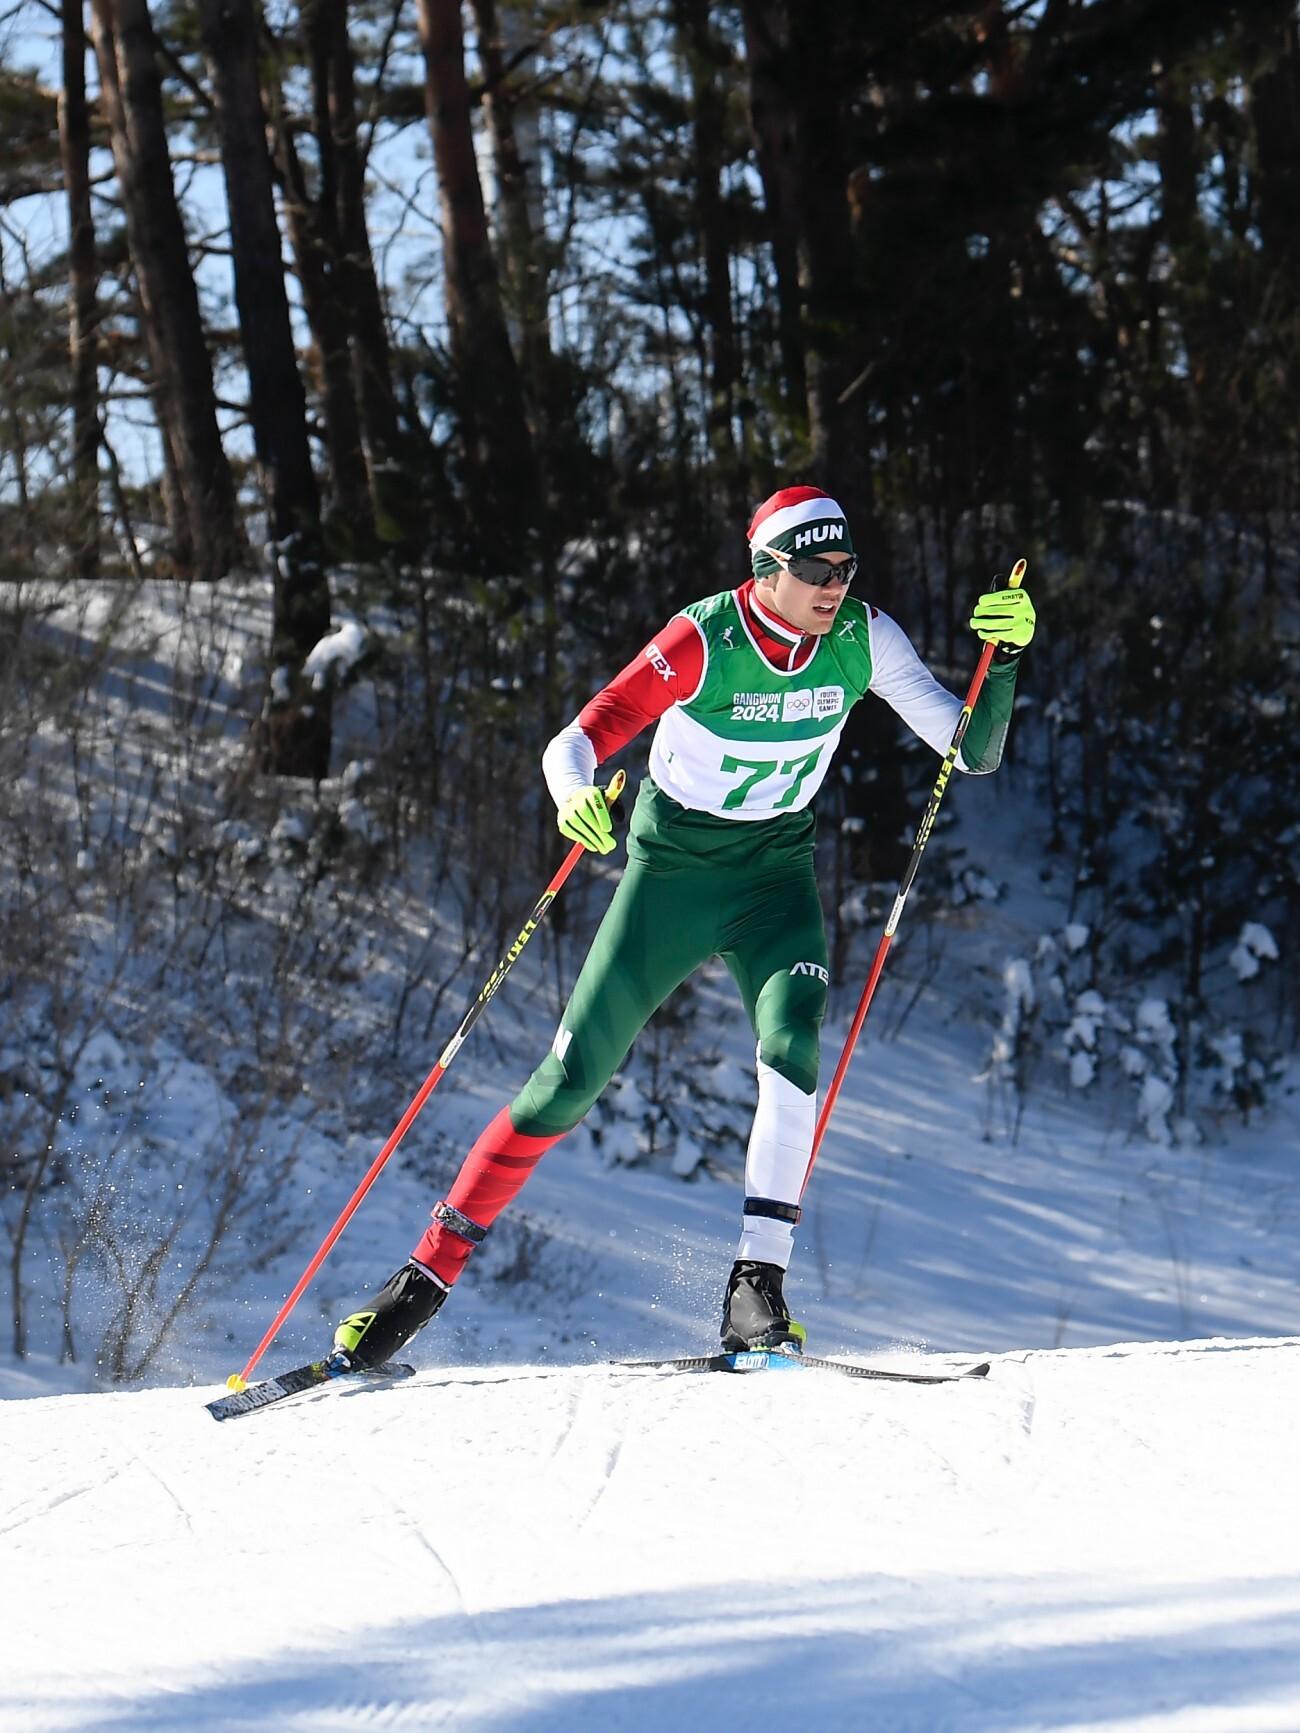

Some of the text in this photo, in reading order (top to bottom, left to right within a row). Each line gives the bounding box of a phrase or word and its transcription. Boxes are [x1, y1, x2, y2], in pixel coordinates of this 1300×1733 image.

[795, 524, 843, 550] HUN
[733, 692, 782, 706] GANGWON
[730, 704, 780, 722] 2024
[720, 742, 826, 810] 77
